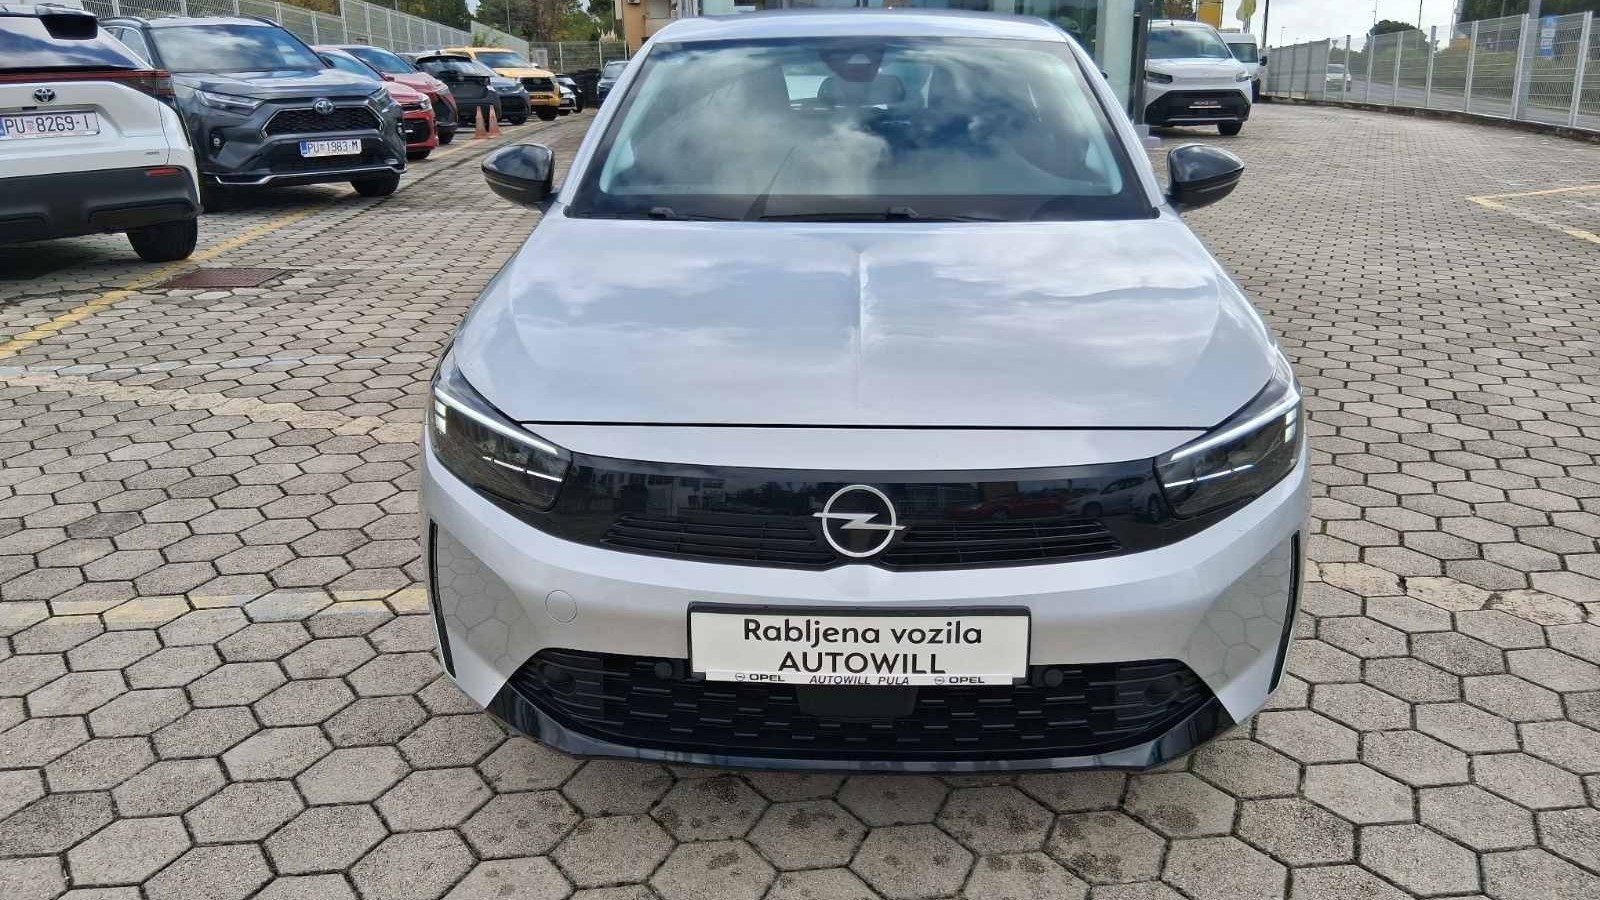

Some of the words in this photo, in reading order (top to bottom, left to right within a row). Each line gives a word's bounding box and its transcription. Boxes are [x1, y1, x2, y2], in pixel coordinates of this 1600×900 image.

[4, 118, 26, 135] PU
[35, 115, 90, 132] 8269-I
[307, 141, 320, 154] PU
[743, 618, 880, 648] Rabljena
[891, 620, 983, 645] vozila
[778, 651, 946, 675] AUTOWILL
[749, 673, 785, 682] OPEL
[809, 675, 871, 685] AUTOWILL
[877, 676, 910, 686] PULA
[948, 676, 985, 684] OPEL
